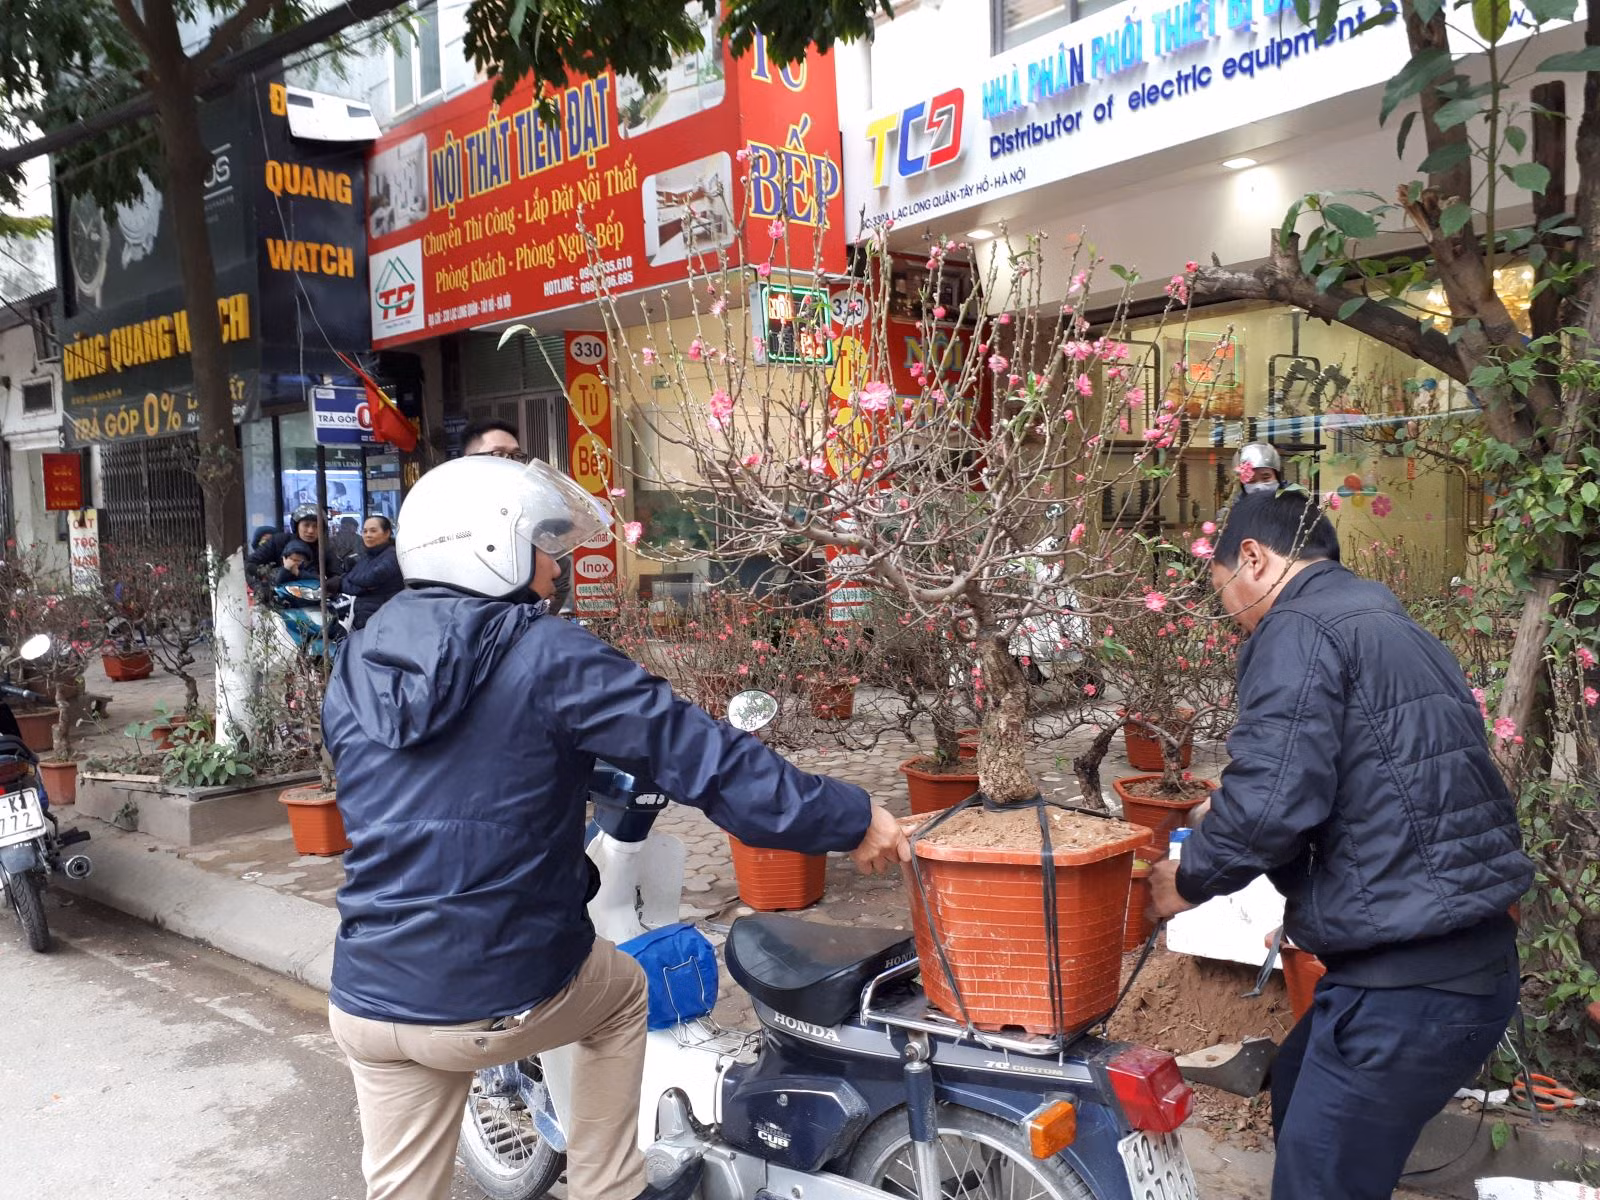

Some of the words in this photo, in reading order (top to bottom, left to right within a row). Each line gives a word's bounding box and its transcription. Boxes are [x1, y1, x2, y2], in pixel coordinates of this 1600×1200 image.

[982, 63, 1023, 120] NHÀ
[1027, 42, 1085, 103] PHÂN
[1091, 5, 1143, 80] PHỐI
[989, 110, 1083, 159] Distributor
[1093, 94, 1114, 122] of
[1128, 64, 1213, 112] electric
[431, 130, 464, 219] NỘI
[464, 100, 512, 198] THẤT
[565, 72, 610, 170] ĐẠT
[266, 160, 353, 205] QUANG
[747, 112, 841, 229] BẾP
[423, 222, 462, 257] Chuyên
[464, 214, 482, 244] Thi
[485, 202, 515, 236] Công
[525, 186, 549, 226] Lắp
[551, 183, 574, 218] Đặt
[577, 169, 600, 210] Nội
[604, 153, 638, 197] Thất
[908, 199, 931, 216] LONG
[265, 238, 354, 278] WATCH
[435, 263, 469, 293] Phòng
[471, 251, 506, 283] Khách
[516, 238, 556, 271] Phòng
[595, 210, 624, 250] Bếp
[543, 275, 575, 296] HOTLINE
[833, 298, 863, 316] 30
[63, 329, 107, 382] ĐĂNG
[109, 315, 173, 373] QUANG
[574, 342, 602, 357] 330
[579, 384, 599, 416] Tủ
[74, 407, 100, 440] TRẢ
[104, 404, 140, 437] GÓP
[318, 412, 336, 423] TRẢ
[338, 412, 358, 423] GÓP
[73, 518, 95, 530] CT
[582, 560, 609, 573] Inox
[885, 951, 915, 969] HOND
[773, 1011, 841, 1042] HONDA
[1012, 1065, 1064, 1076] CUSTOM
[757, 1130, 789, 1148] CUB
